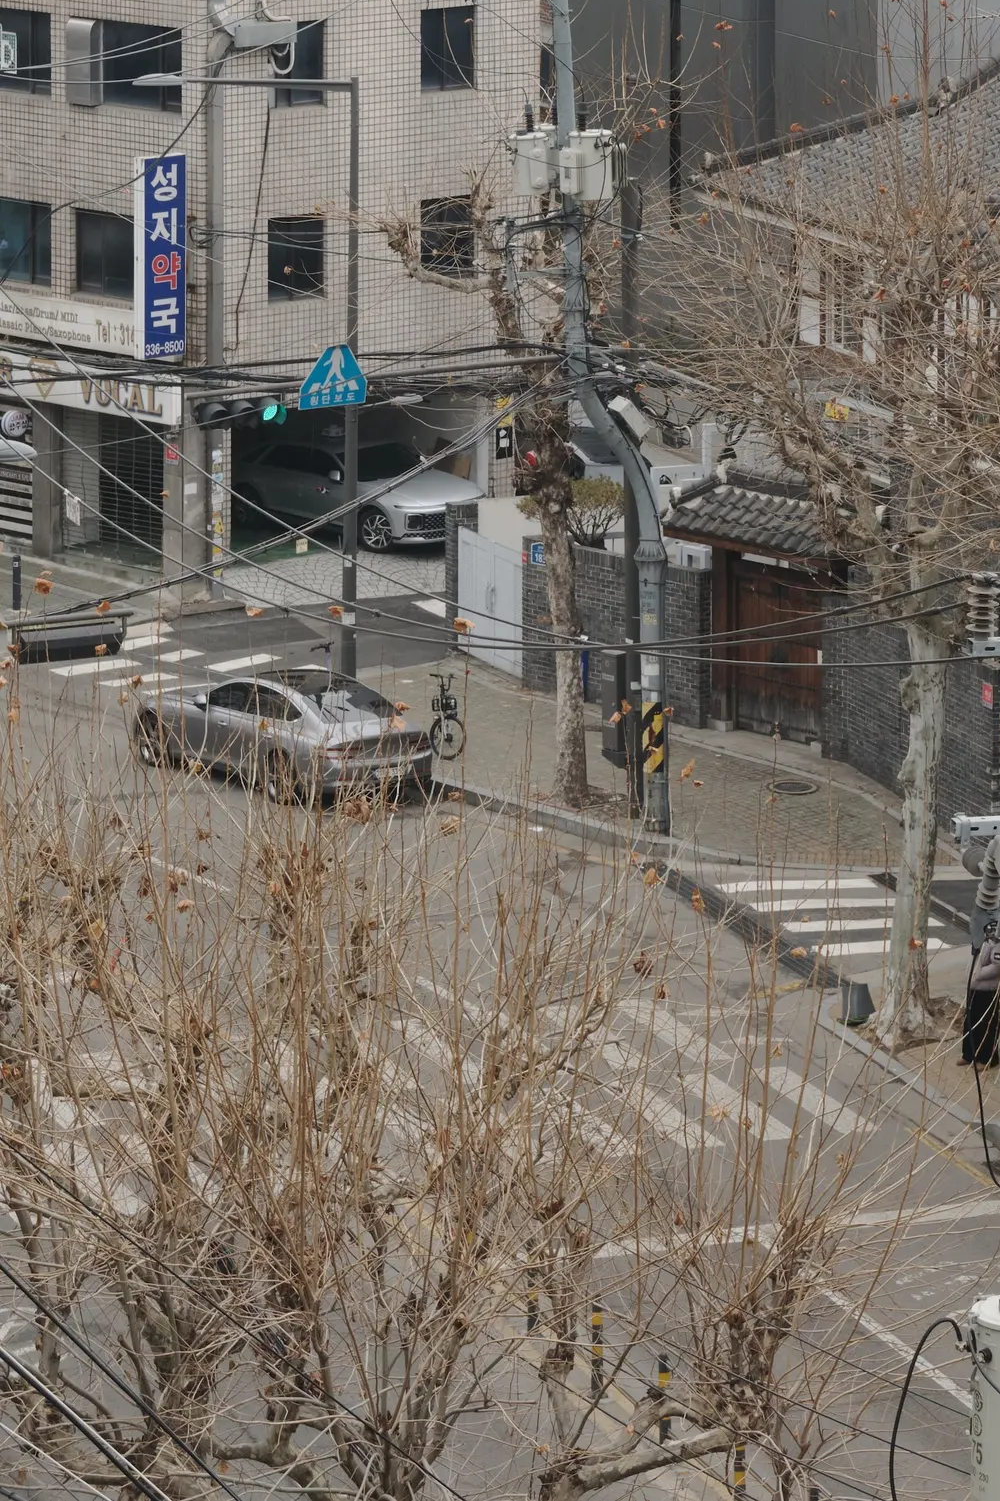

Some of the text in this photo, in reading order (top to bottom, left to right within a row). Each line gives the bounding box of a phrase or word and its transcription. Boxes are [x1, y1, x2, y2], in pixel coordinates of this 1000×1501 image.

[150, 163, 182, 334] 성지약국
[60, 310, 79, 324] MIDI
[145, 339, 184, 357] 336-8500
[80, 379, 163, 416] VOCAL
